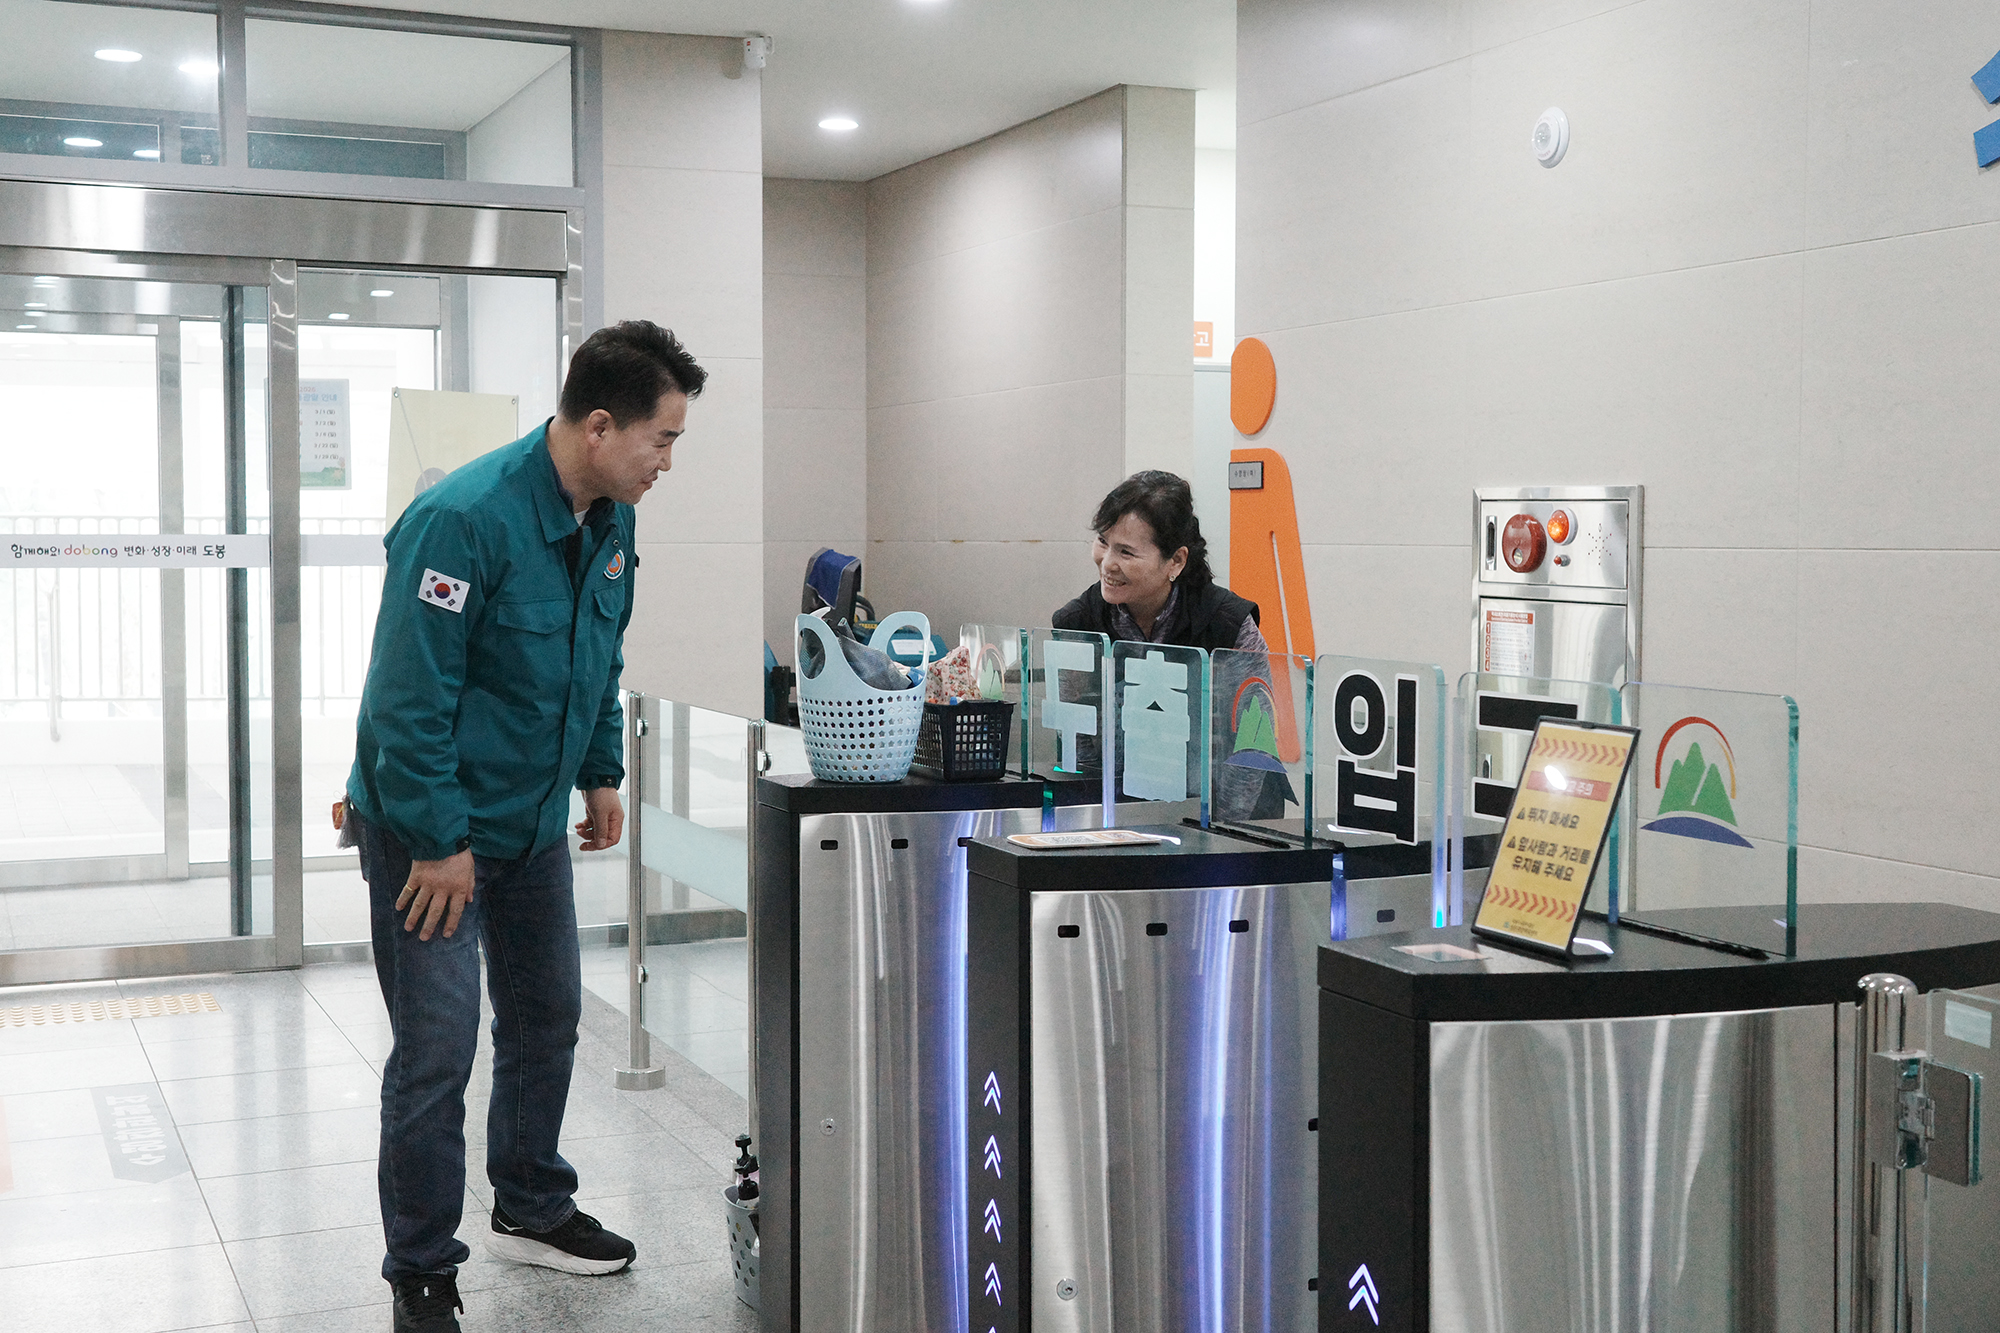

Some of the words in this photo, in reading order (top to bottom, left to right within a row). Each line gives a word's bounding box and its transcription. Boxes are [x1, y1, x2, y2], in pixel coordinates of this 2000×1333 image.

[64, 543, 118, 559] dobong
[203, 544, 226, 559] 도봉
[1549, 811, 1580, 829] 마세요
[1518, 836, 1559, 858] 앞사람과
[1560, 845, 1591, 865] 거리를
[1512, 855, 1543, 875] 유지해
[1543, 862, 1575, 882] 주세요
